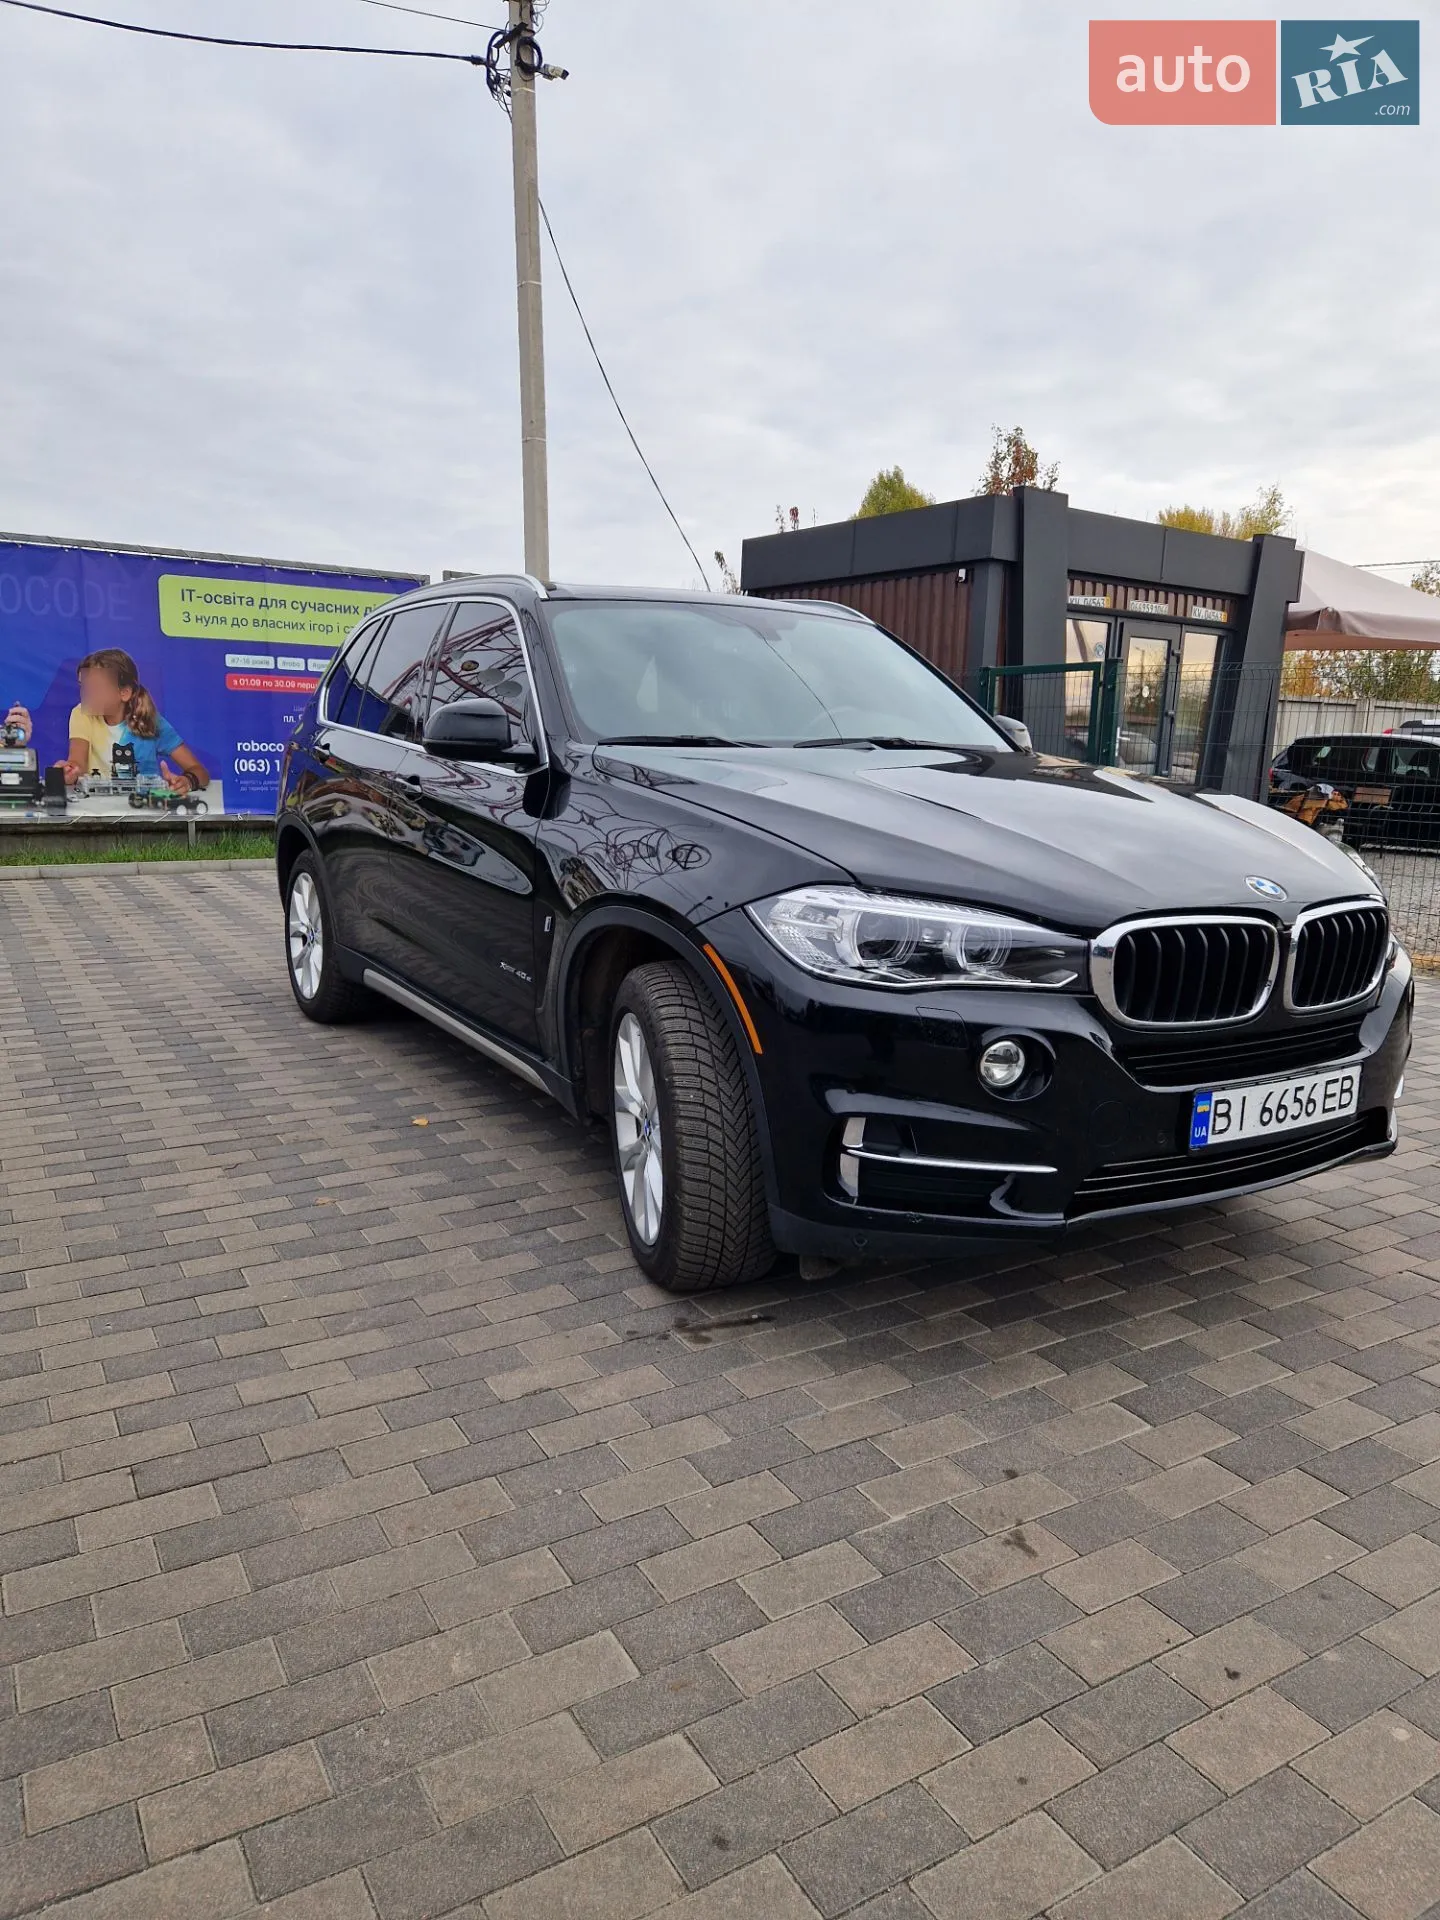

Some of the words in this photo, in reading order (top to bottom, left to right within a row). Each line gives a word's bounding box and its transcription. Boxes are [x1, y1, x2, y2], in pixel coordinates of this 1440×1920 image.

[258, 597, 287, 610] для
[290, 600, 360, 615] сучасних
[182, 611, 191, 623] З
[195, 614, 227, 627] нуля
[230, 617, 249, 628] до
[252, 618, 305, 631] власних
[309, 620, 333, 634] ігор
[337, 623, 340, 633] і
[239, 678, 261, 687] 01.09
[274, 680, 296, 688] 30.09
[234, 758, 270, 775] (063)
[1211, 1095, 1247, 1136] BI
[1259, 1083, 1319, 1127] 6656
[1322, 1075, 1354, 1114] EB
[1195, 1126, 1207, 1138] UA
